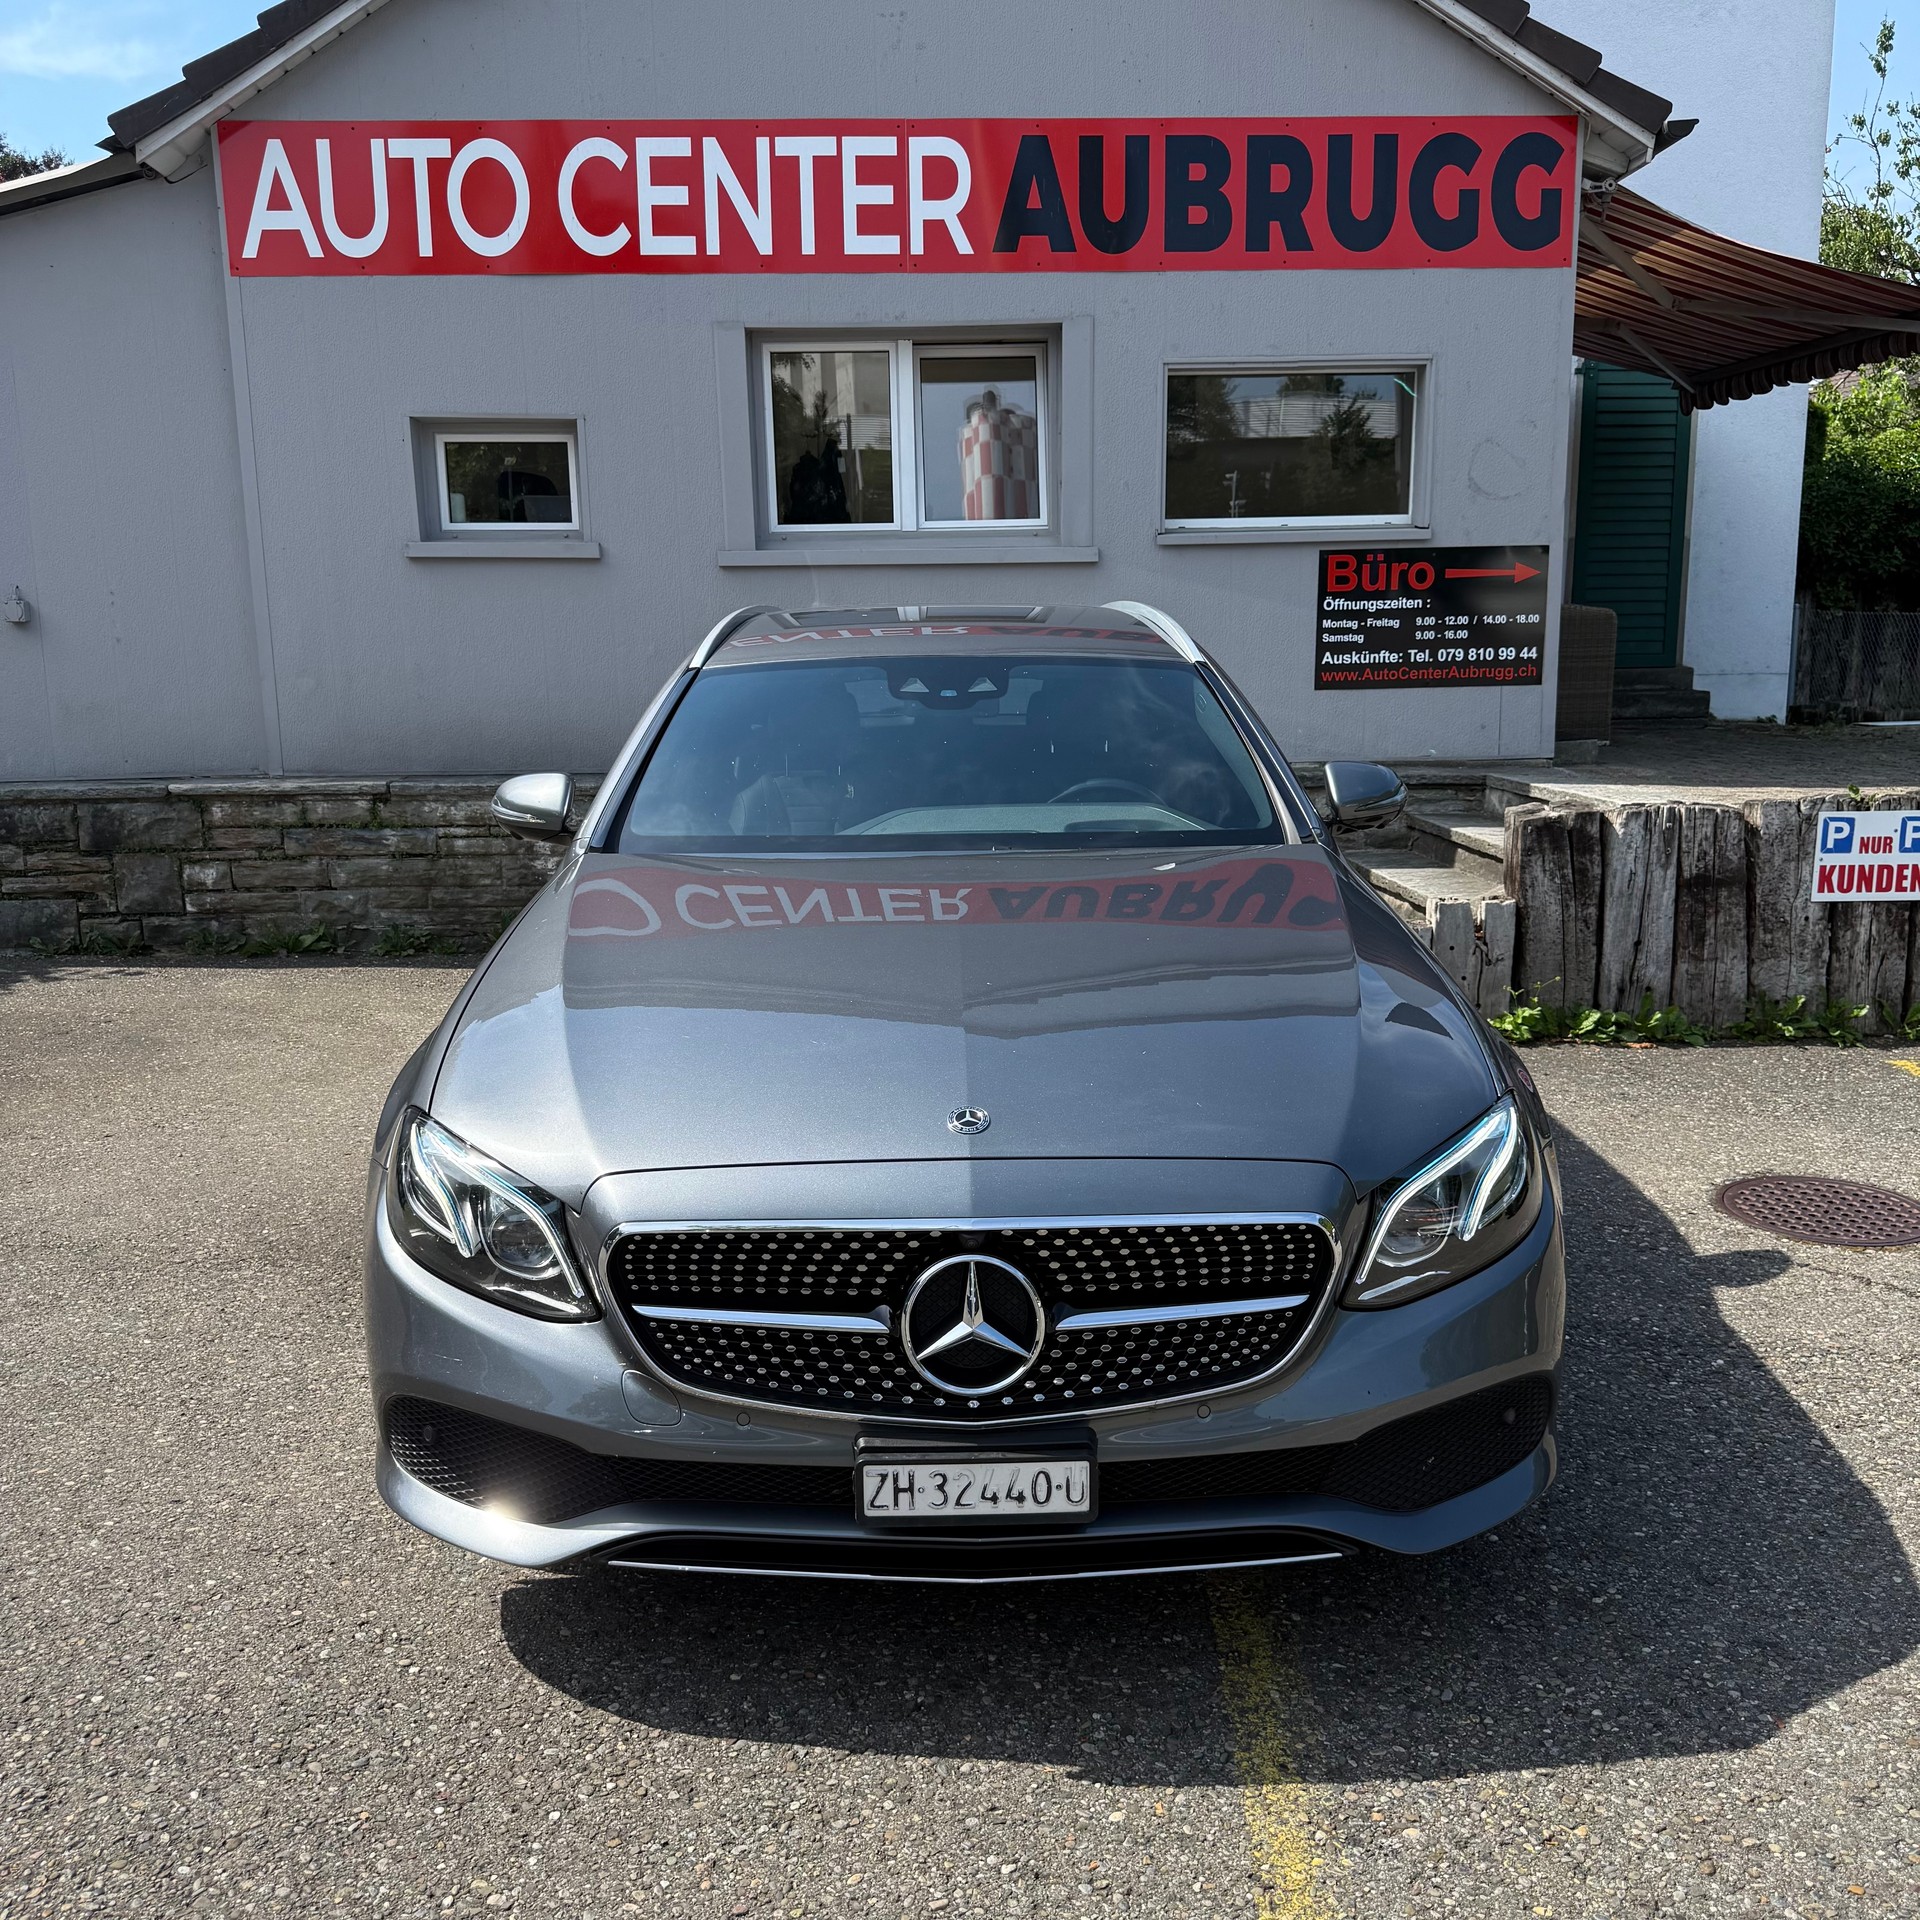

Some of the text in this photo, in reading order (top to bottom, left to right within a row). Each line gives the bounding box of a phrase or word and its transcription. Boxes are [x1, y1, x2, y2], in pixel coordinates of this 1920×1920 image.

[242, 131, 1565, 260] AUTO CENTER AUBRUGG
[1327, 553, 1436, 592] Büro
[1323, 596, 1422, 612] Öffnungszeiten
[1322, 619, 1358, 629] Montag
[1366, 618, 1400, 629] Freitag
[1415, 616, 1436, 626] 9.00
[1444, 616, 1469, 625] 12.00
[1482, 615, 1507, 624] 14.00
[1515, 614, 1540, 624] 18.00
[1322, 633, 1364, 643] Samstag
[1415, 631, 1435, 640] 9.00
[1444, 630, 1468, 639] 16.00
[1321, 646, 1538, 664] Auskünfte: Tel. 079 810 99 44
[1321, 664, 1537, 682] www.AutoCenterAubrugg.ch
[1826, 821, 1851, 849] P
[1859, 836, 1893, 854] NUR
